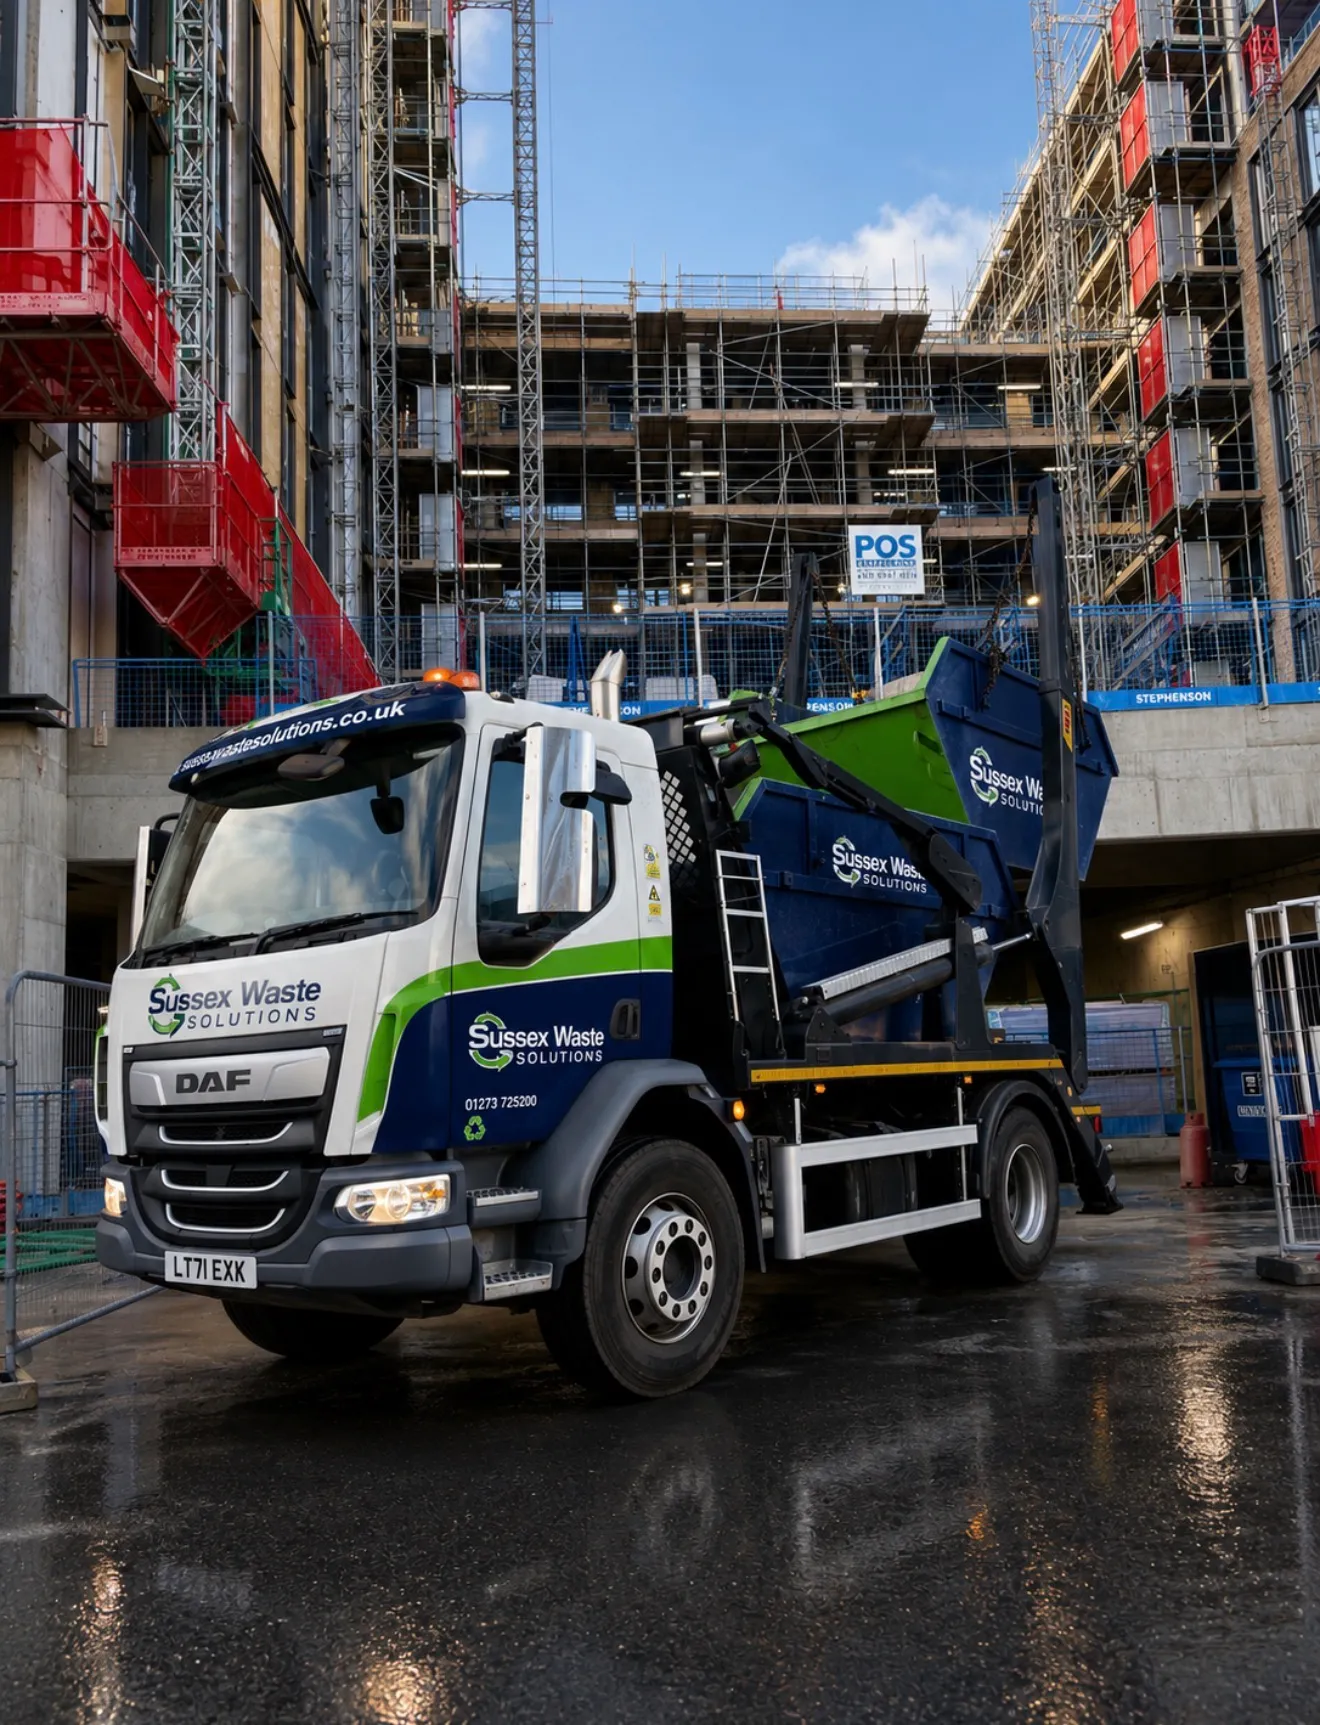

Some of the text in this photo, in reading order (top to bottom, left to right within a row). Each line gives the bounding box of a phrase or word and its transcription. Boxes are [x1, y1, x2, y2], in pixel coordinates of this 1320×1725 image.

[855, 534, 917, 559] POS
[1136, 691, 1211, 704] STEPHENSON
[969, 755, 1024, 796] Sussex
[832, 843, 888, 874] Sussex
[863, 874, 927, 894] SOLUTIONS
[148, 979, 322, 1015] Sussex Waste
[186, 1006, 316, 1030] SOLUTIONS
[468, 1024, 605, 1049] Sussex Waste
[515, 1050, 603, 1066] SOLUTIONS
[176, 1068, 252, 1094] DAF
[465, 1095, 537, 1111] 01273 725200
[174, 1255, 246, 1284] LT71 EXK
